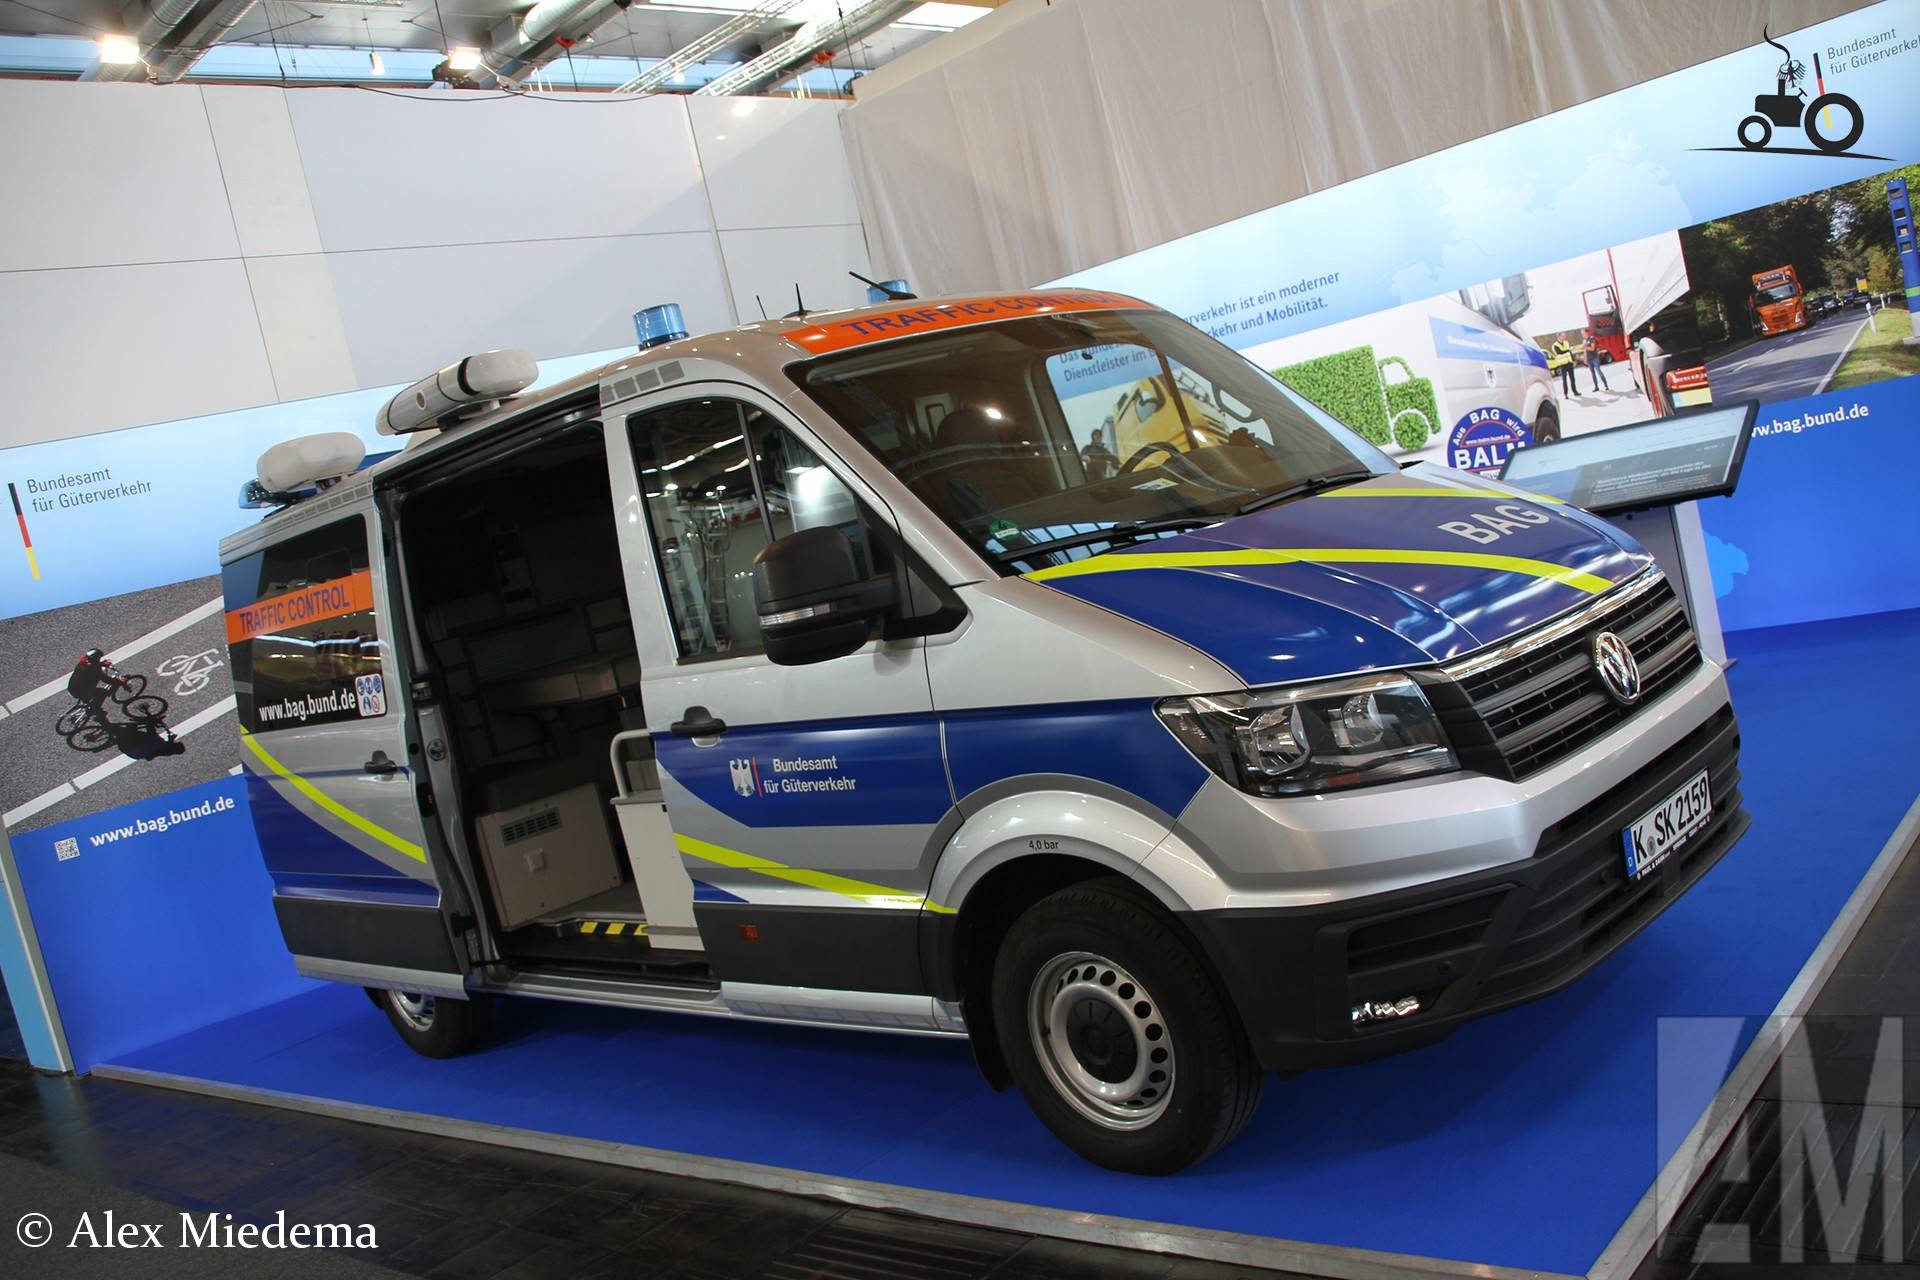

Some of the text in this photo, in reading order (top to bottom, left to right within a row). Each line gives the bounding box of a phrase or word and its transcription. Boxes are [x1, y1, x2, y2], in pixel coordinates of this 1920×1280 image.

[1827, 28, 1897, 60] Bundesamt
[1830, 61, 1847, 75] für
[1240, 296, 1255, 311] ist
[1257, 290, 1276, 305] ein
[1279, 271, 1340, 299] moderner
[840, 302, 996, 335] TRAFFIC
[1241, 312, 1264, 331] und
[1267, 296, 1328, 323] Mobilität.
[1064, 355, 1129, 382] Dienstleister
[1132, 350, 1146, 361] im
[1469, 409, 1500, 424] BAG
[1506, 418, 1525, 437] wird
[27, 468, 112, 494] Bundesamt
[32, 480, 152, 513] für Güterverkehr
[1437, 505, 1550, 545] BAG
[240, 584, 351, 635] TRAFFIC CONTROL
[258, 687, 356, 722] www.bag.bund.de
[772, 755, 838, 773] Bundesamt
[763, 776, 856, 794] für Güterverkehr
[90, 796, 236, 847] www.bag.bund.de
[1633, 824, 1647, 864] K
[1654, 803, 1676, 846] SK
[1675, 776, 1708, 830] 2159
[1029, 839, 1059, 852] 4,0 bar
